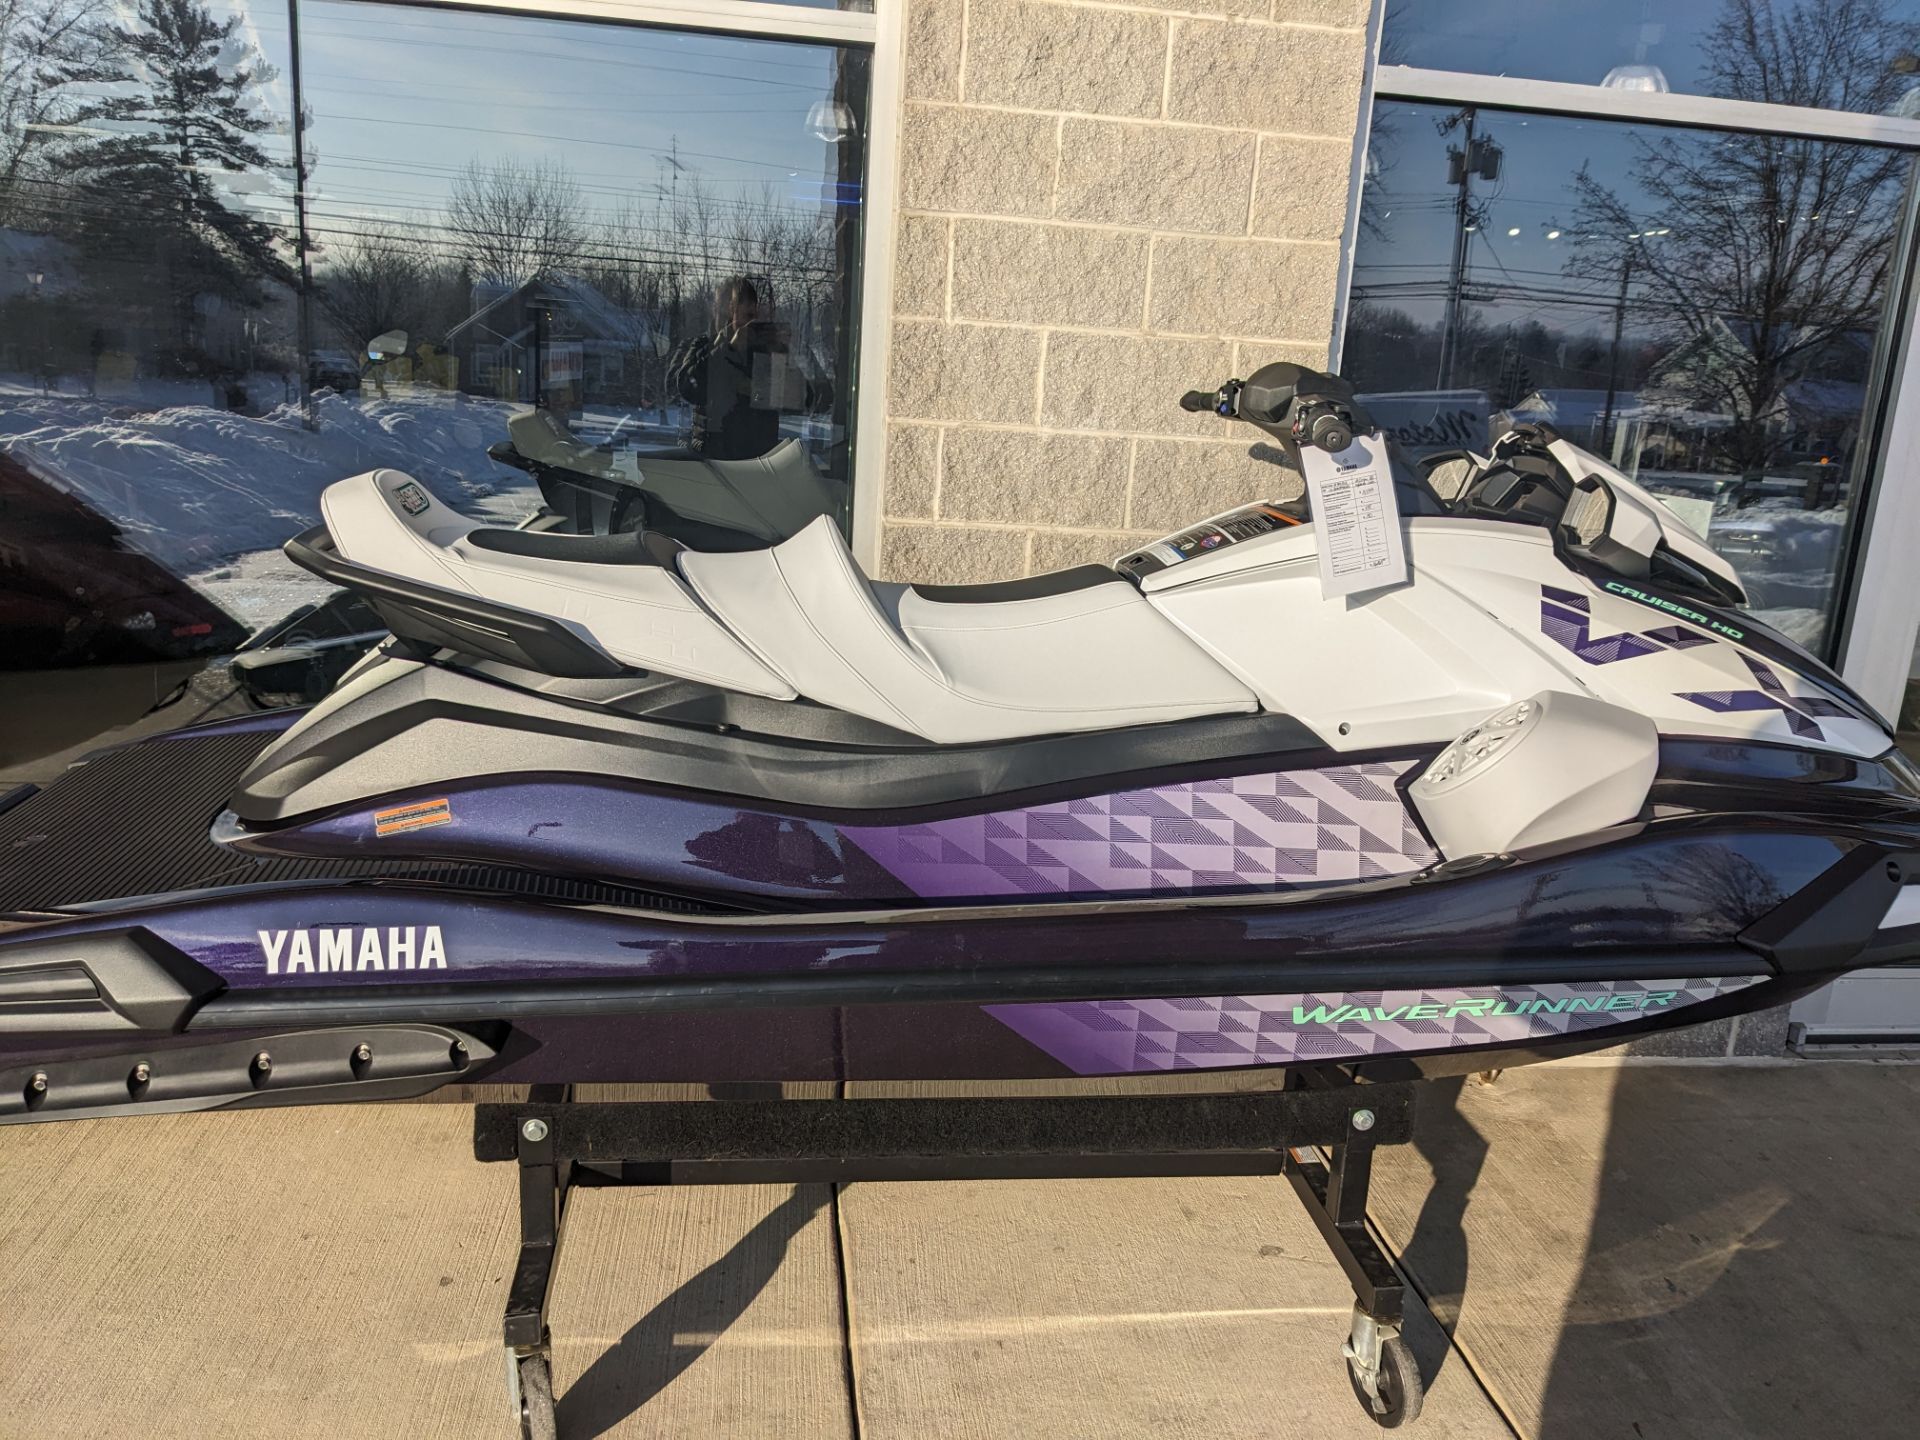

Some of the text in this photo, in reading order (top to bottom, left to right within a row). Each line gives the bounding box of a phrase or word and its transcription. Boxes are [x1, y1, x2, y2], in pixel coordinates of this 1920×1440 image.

[1605, 581, 1744, 640] CRUISER HD
[258, 925, 448, 975] YAMAHA
[1292, 991, 1677, 1026] WAVERUNNER
